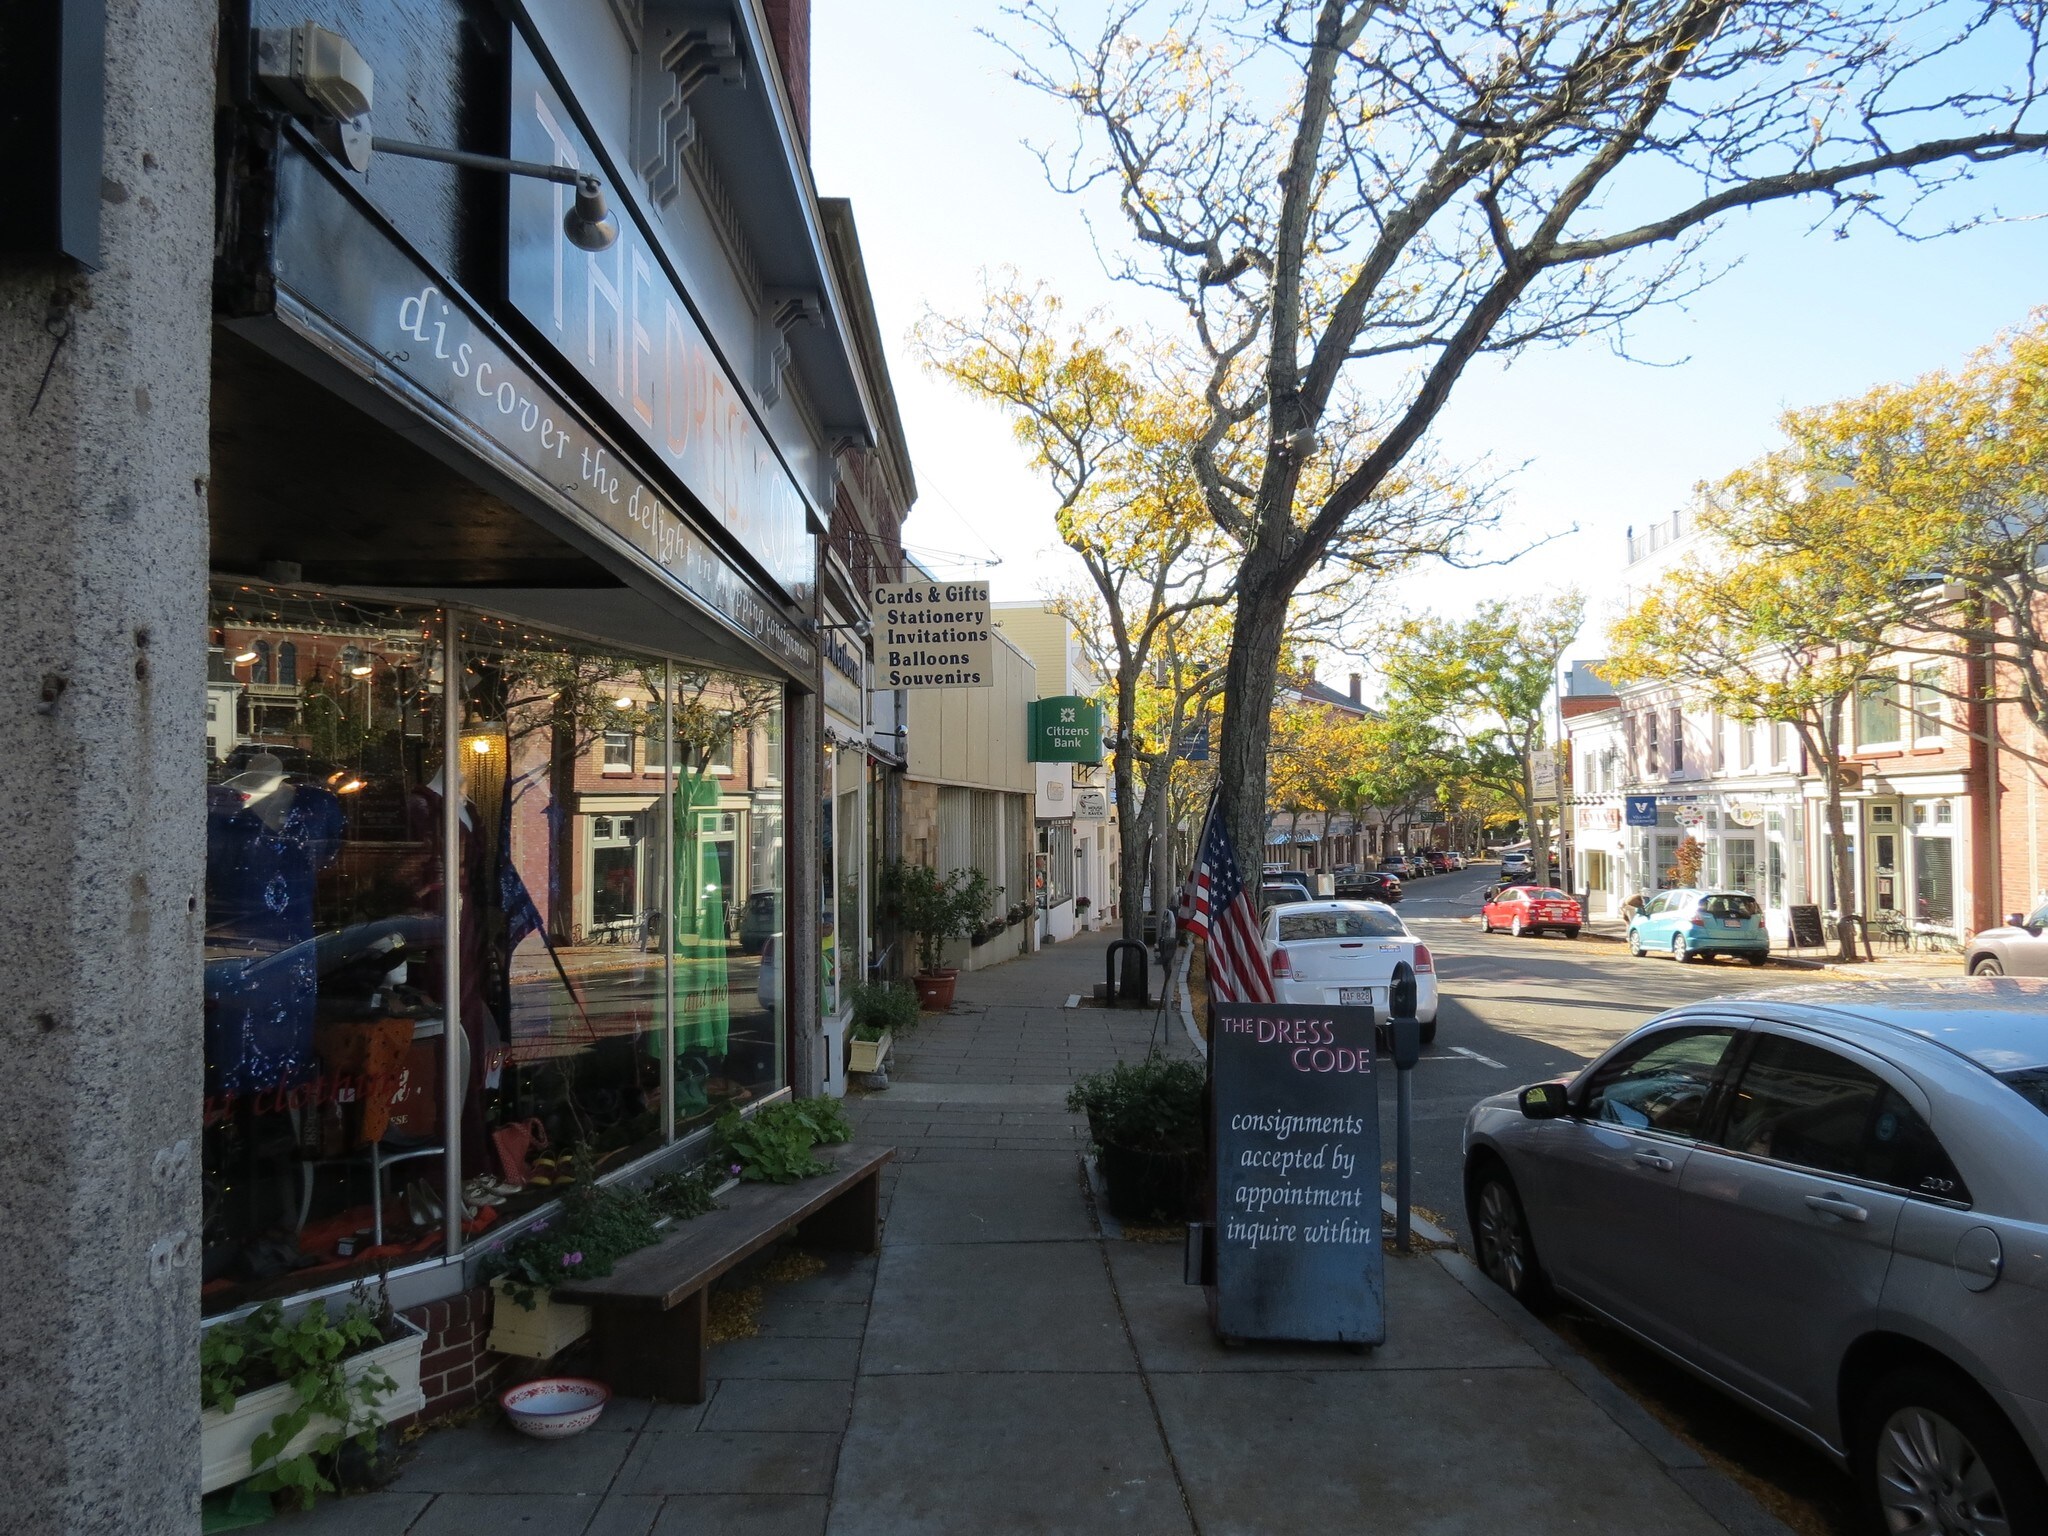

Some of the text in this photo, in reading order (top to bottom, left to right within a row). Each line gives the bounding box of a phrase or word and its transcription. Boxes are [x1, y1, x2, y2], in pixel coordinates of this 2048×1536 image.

[535, 90, 652, 431] THE
[399, 286, 570, 459] discover
[581, 446, 619, 504] the
[628, 484, 693, 565] delight
[698, 545, 711, 582] in
[715, 567, 764, 636] shopping
[875, 585, 988, 604] Cards & Gifts
[887, 609, 984, 625] Stationery
[888, 628, 988, 644] Invitations
[889, 651, 969, 667] Balloons
[889, 669, 980, 686] Souvenirs
[1046, 726, 1089, 736] Citizens
[1054, 737, 1081, 748] Bank
[1221, 1018, 1335, 1045] THE DRESS
[1291, 1046, 1371, 1073] CODE
[1231, 1108, 1363, 1140] consignments
[1241, 1143, 1355, 1178] accepted by
[1920, 1176, 1953, 1191] 200
[1235, 1181, 1363, 1212] appointment
[1227, 1216, 1372, 1250] inquire within
